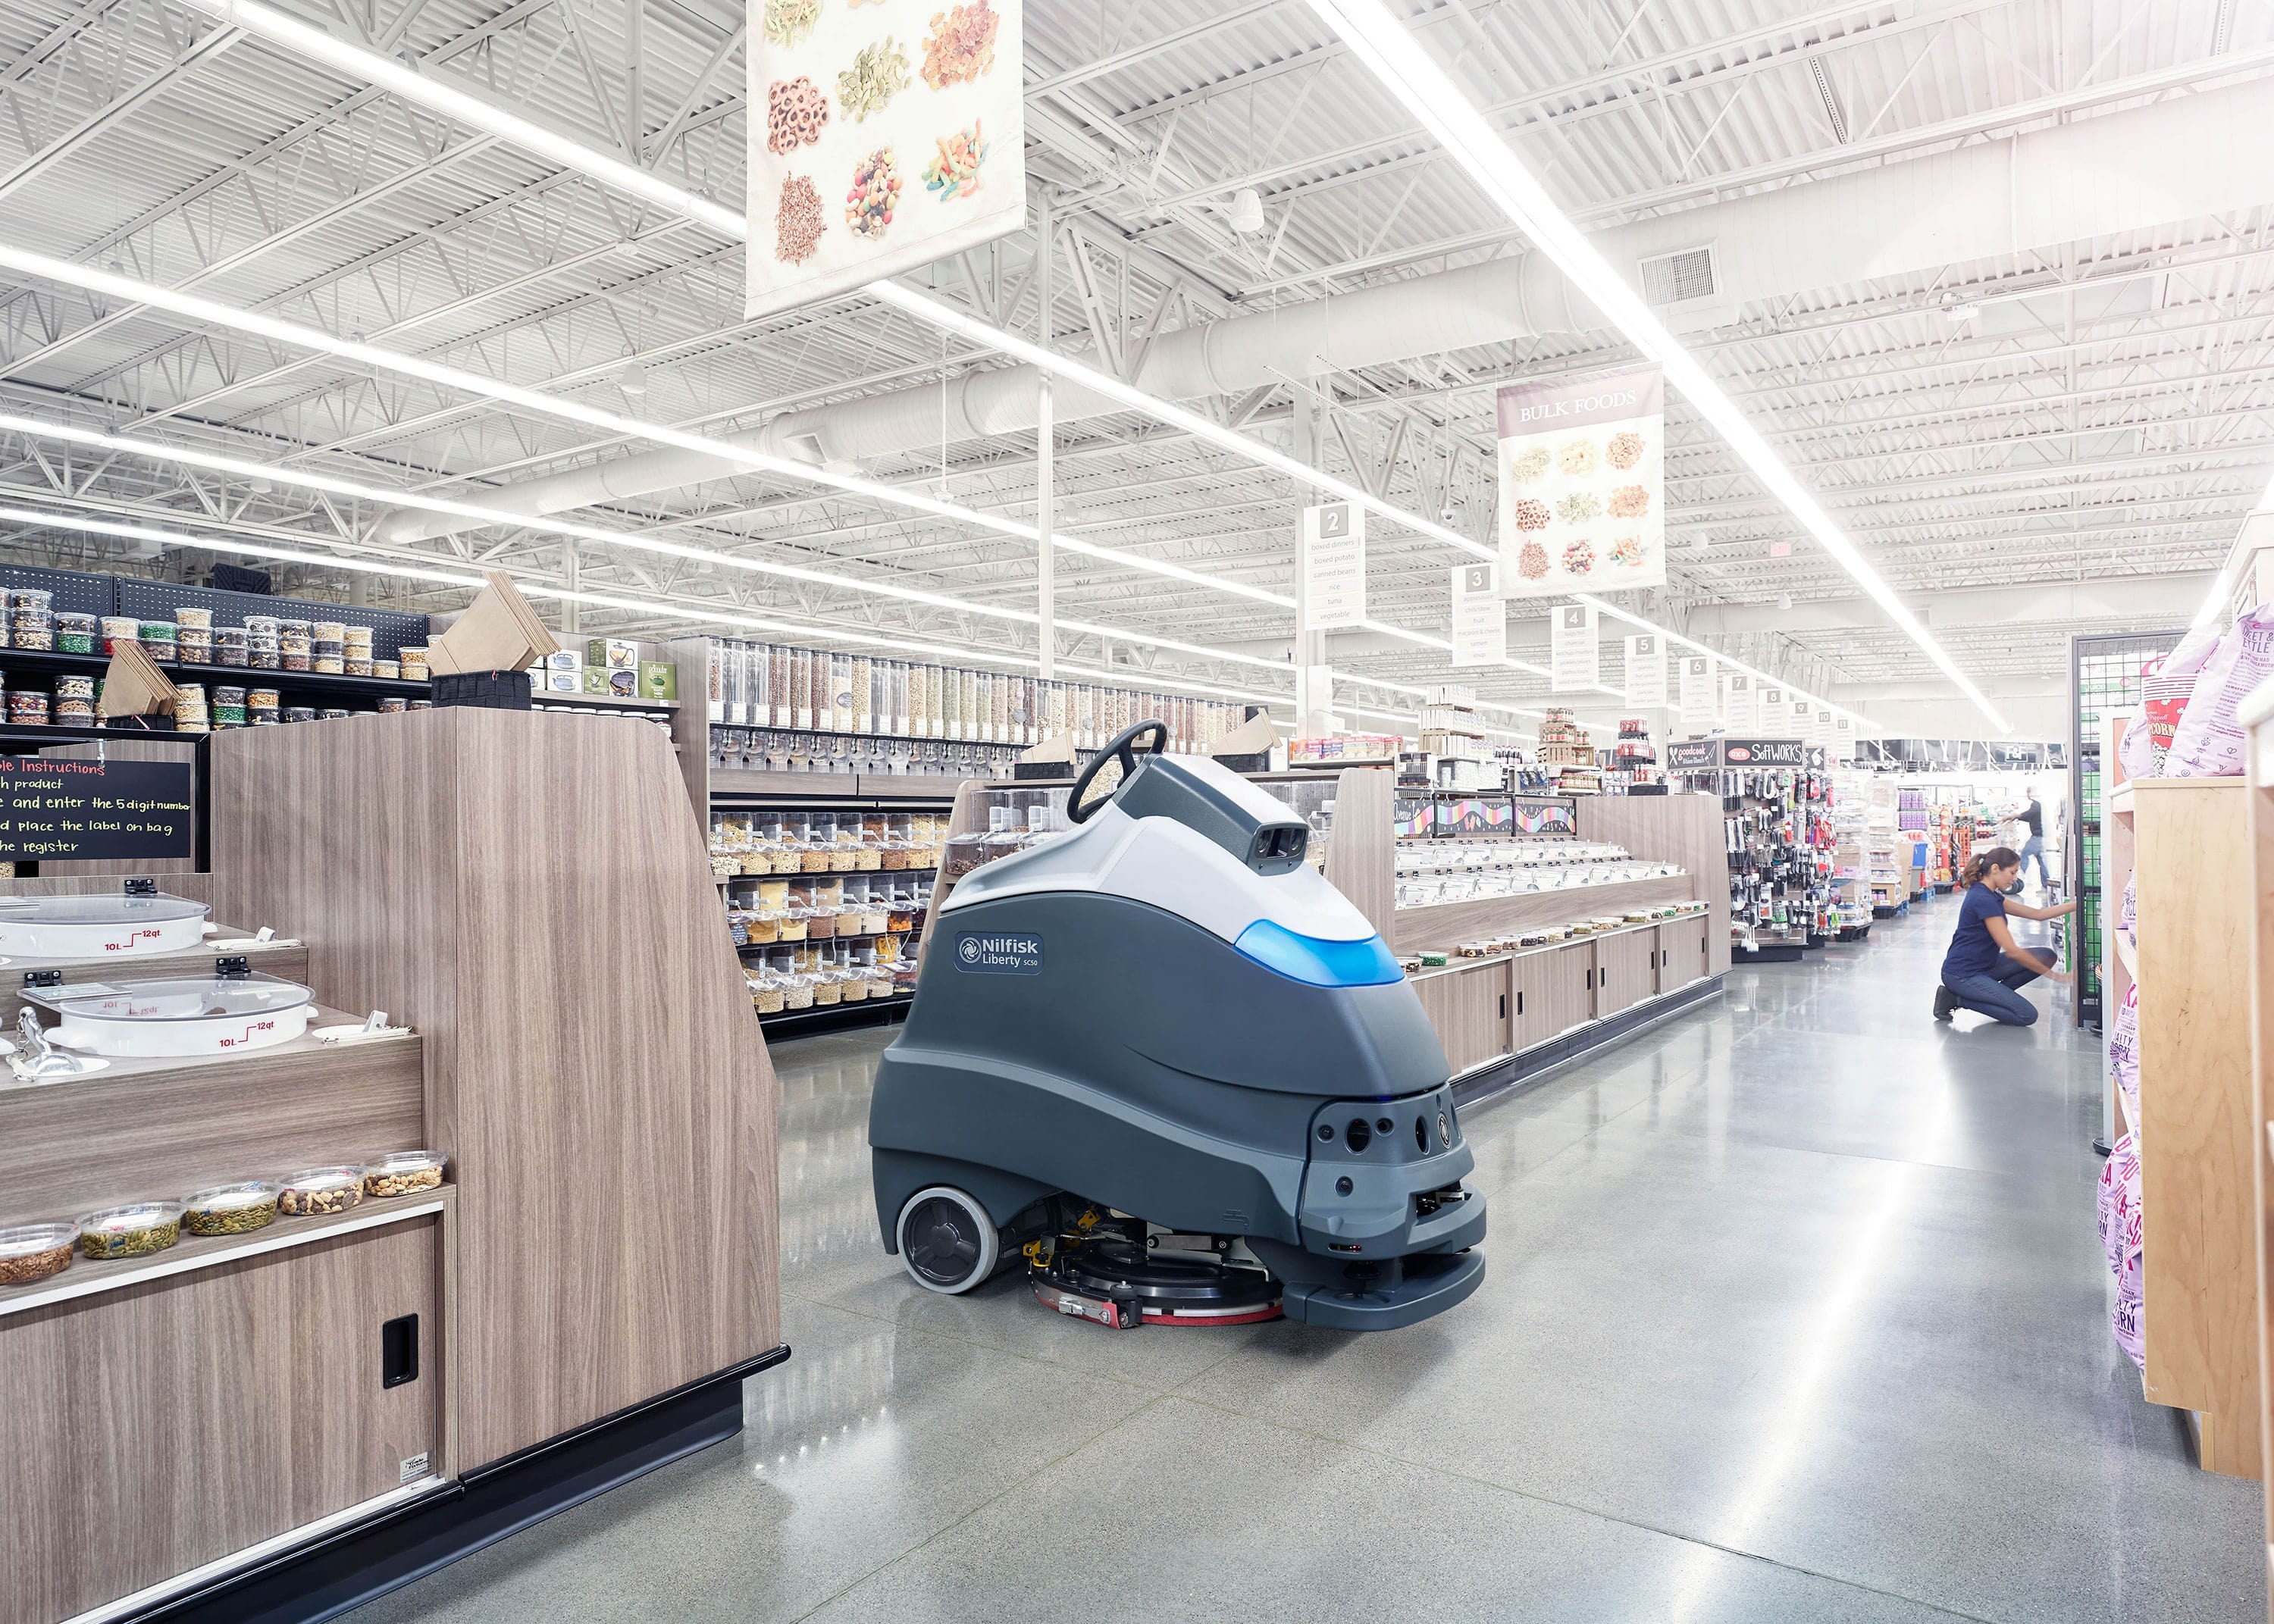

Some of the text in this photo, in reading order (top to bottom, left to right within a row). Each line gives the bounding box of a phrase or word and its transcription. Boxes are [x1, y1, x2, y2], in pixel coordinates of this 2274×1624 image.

[1520, 390, 1637, 423] BULK FOODS
[1327, 512, 1339, 531] 2
[1311, 540, 1354, 551] boxed dinners
[1314, 553, 1355, 564] boxed potato
[1473, 571, 1483, 587] 3
[1320, 611, 1350, 621] vegetable
[1569, 610, 1579, 624] 4
[1640, 639, 1649, 651] 5
[1693, 661, 1702, 671] 6
[1736, 678, 1742, 687] 7
[1770, 693, 1777, 701] 8
[1678, 743, 1706, 761] goodcook
[1751, 743, 1802, 763] SoftWORKS
[22, 759, 105, 776] Instructions
[14, 778, 64, 791] product
[12, 796, 40, 809] and
[46, 796, 85, 809] enter
[92, 796, 114, 809] the
[116, 799, 125, 809] 5
[127, 799, 155, 813] digit
[18, 821, 55, 832] place
[60, 819, 84, 831] the
[89, 819, 121, 831] label
[127, 823, 143, 831] on
[146, 822, 174, 836] bag
[23, 839, 80, 854] register
[105, 943, 122, 951] 10L
[982, 939, 1038, 954] Nilfisk
[982, 953, 1021, 968] Liberty
[219, 1039, 236, 1047] 10L
